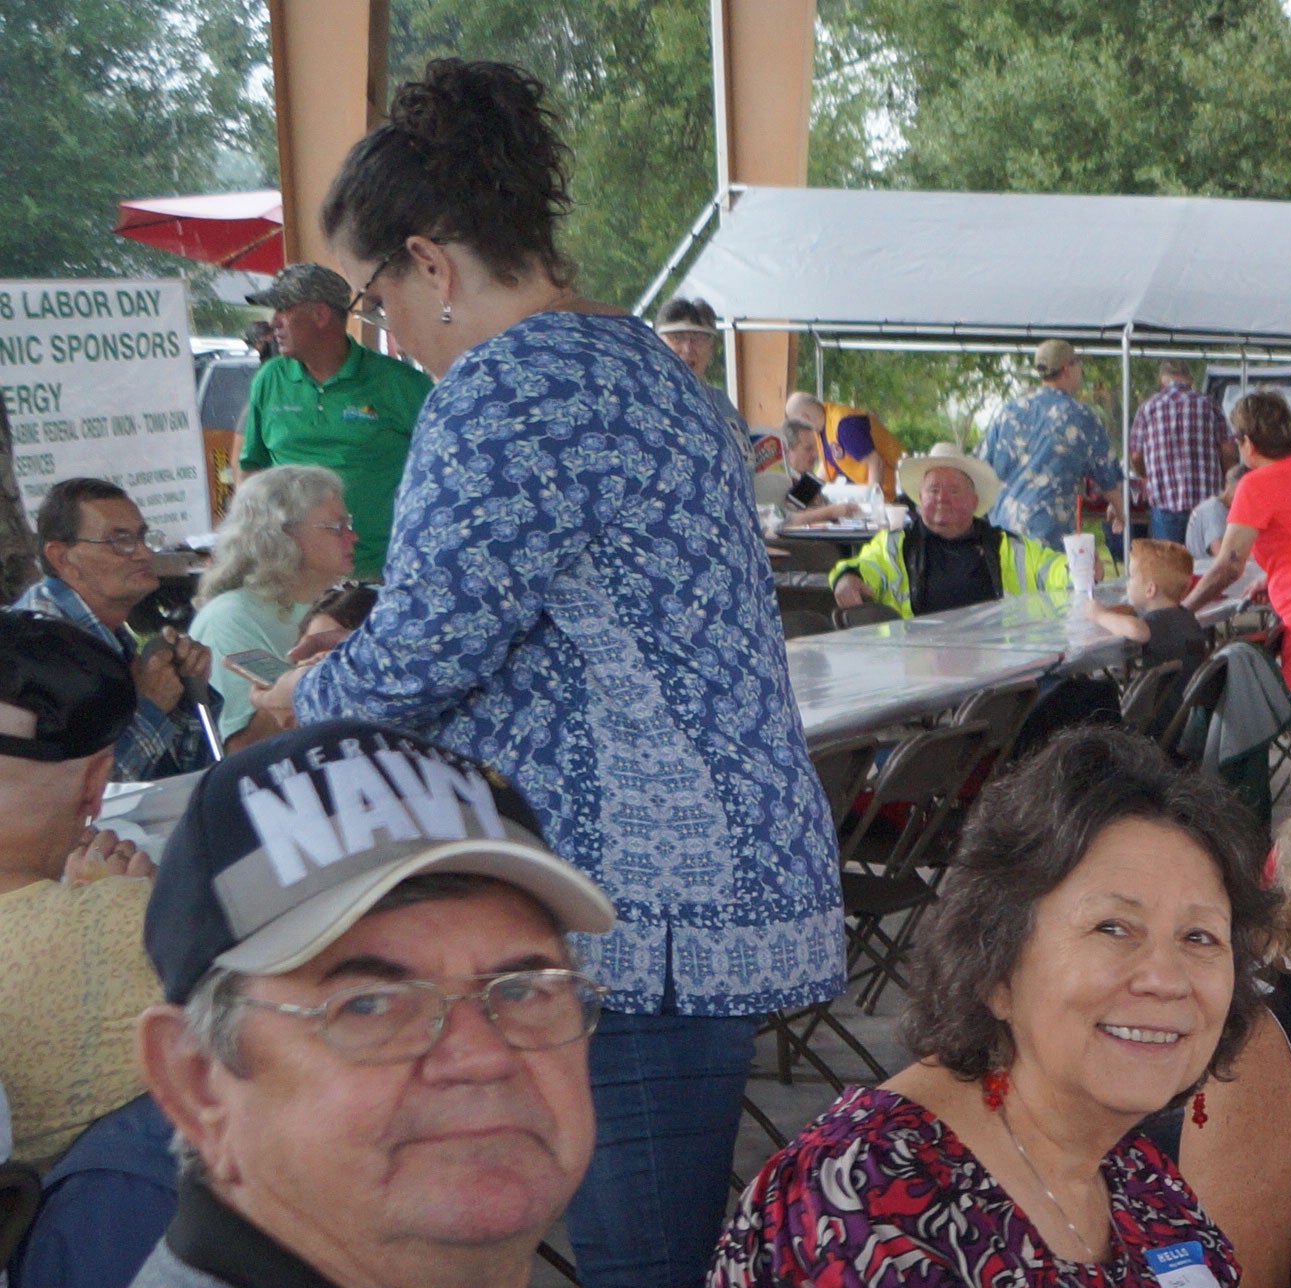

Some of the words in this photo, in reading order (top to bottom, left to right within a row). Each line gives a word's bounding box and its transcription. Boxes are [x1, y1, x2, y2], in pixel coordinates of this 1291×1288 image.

[22, 290, 113, 319] LABOR
[117, 289, 161, 317] DAY
[0, 335, 43, 366] NIC
[51, 331, 181, 364] SPONSORS
[2, 383, 62, 416] ERGY
[243, 750, 507, 888] NAVY
[1156, 1247, 1190, 1263] HELLO
